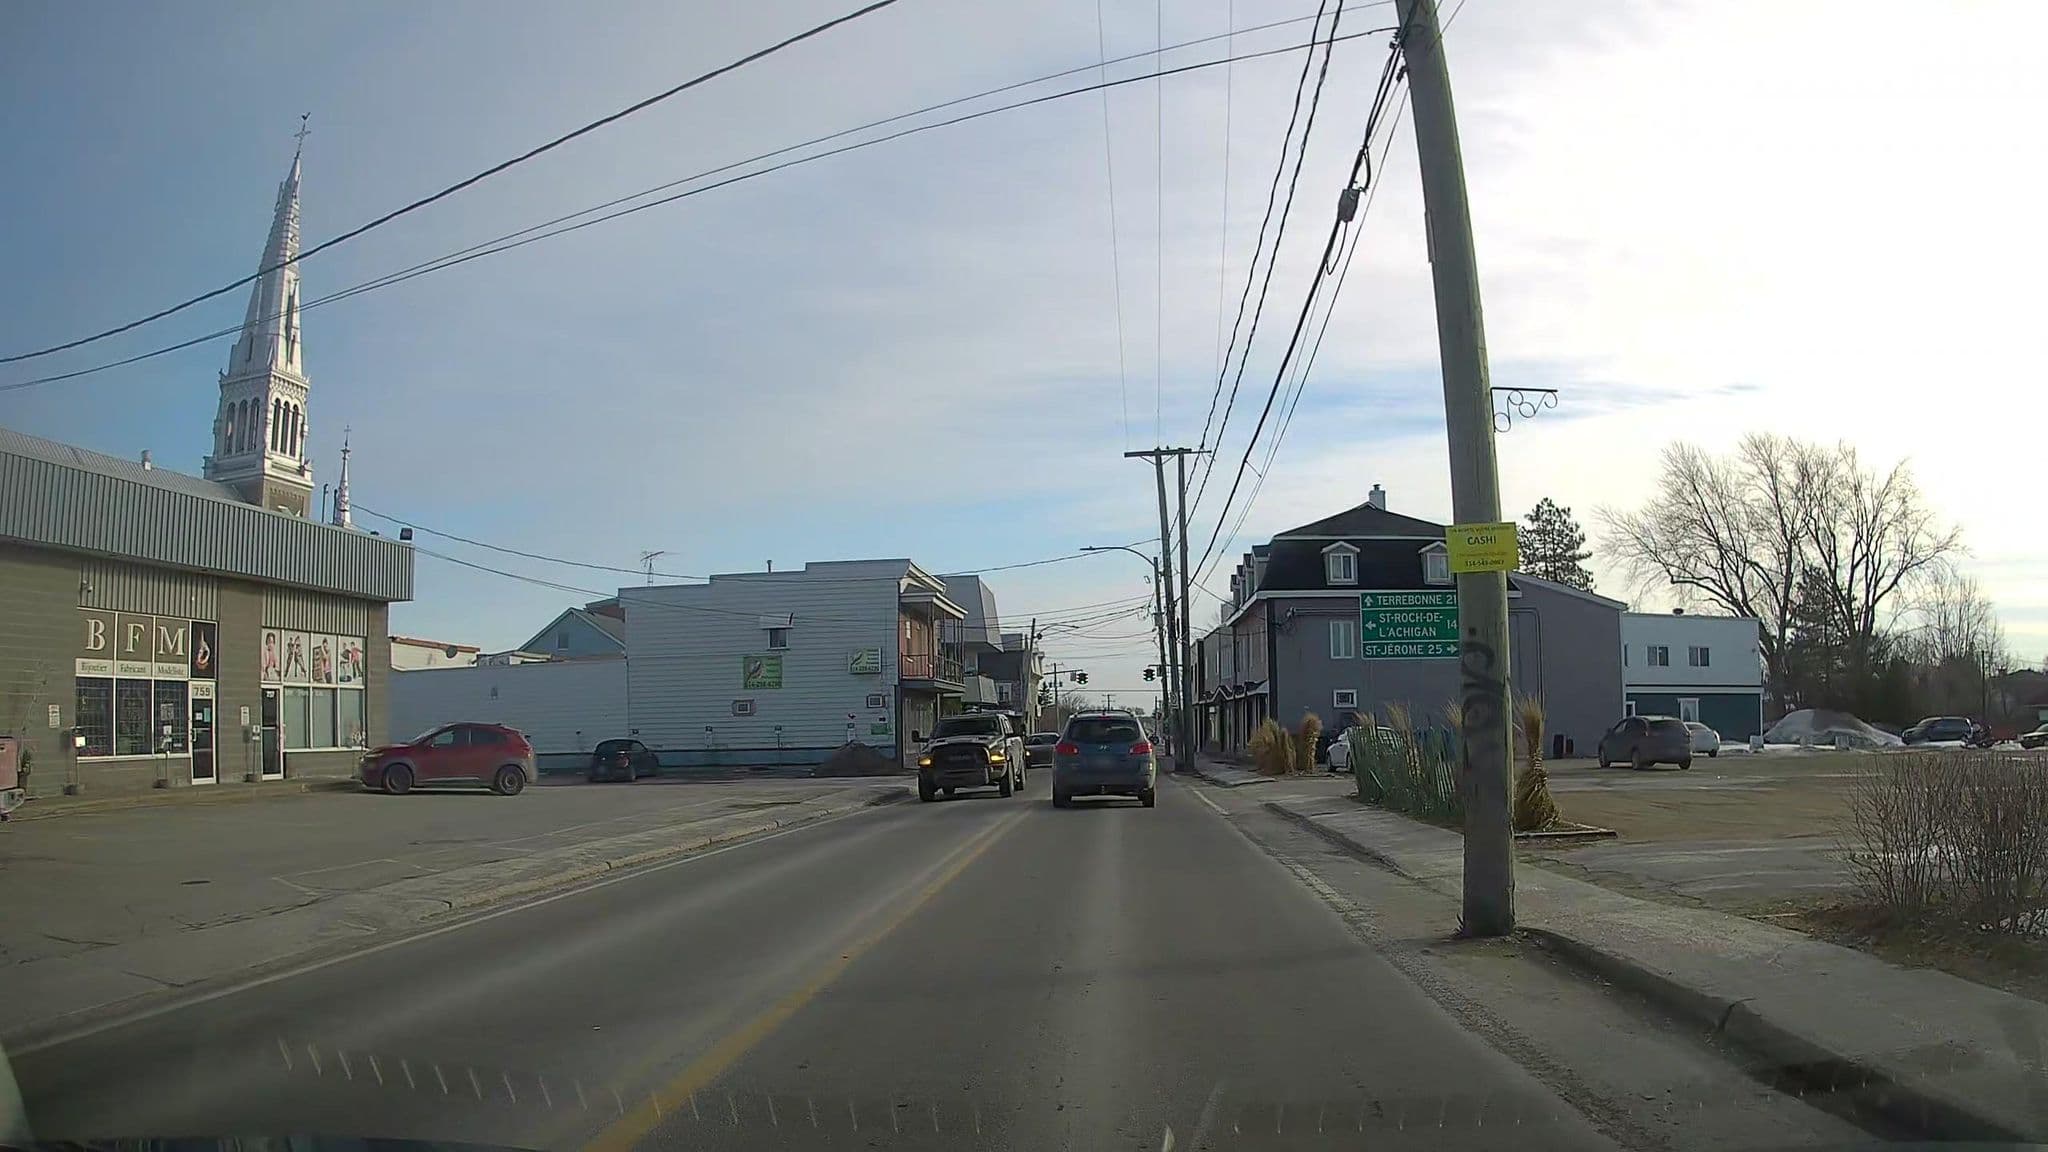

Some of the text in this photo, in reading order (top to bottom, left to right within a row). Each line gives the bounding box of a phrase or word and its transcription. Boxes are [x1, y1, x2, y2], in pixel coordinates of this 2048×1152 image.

[1467, 535, 1497, 545] CASH!
[1376, 594, 1457, 606] TERREBONNE 21
[1379, 612, 1443, 624] ST-ROCH-DE-
[1446, 619, 1458, 630] 14
[1379, 627, 1437, 638] L'ACHIGAN
[1428, 644, 1443, 655] 25
[120, 663, 147, 674] Fabricant
[193, 686, 211, 697] 759
